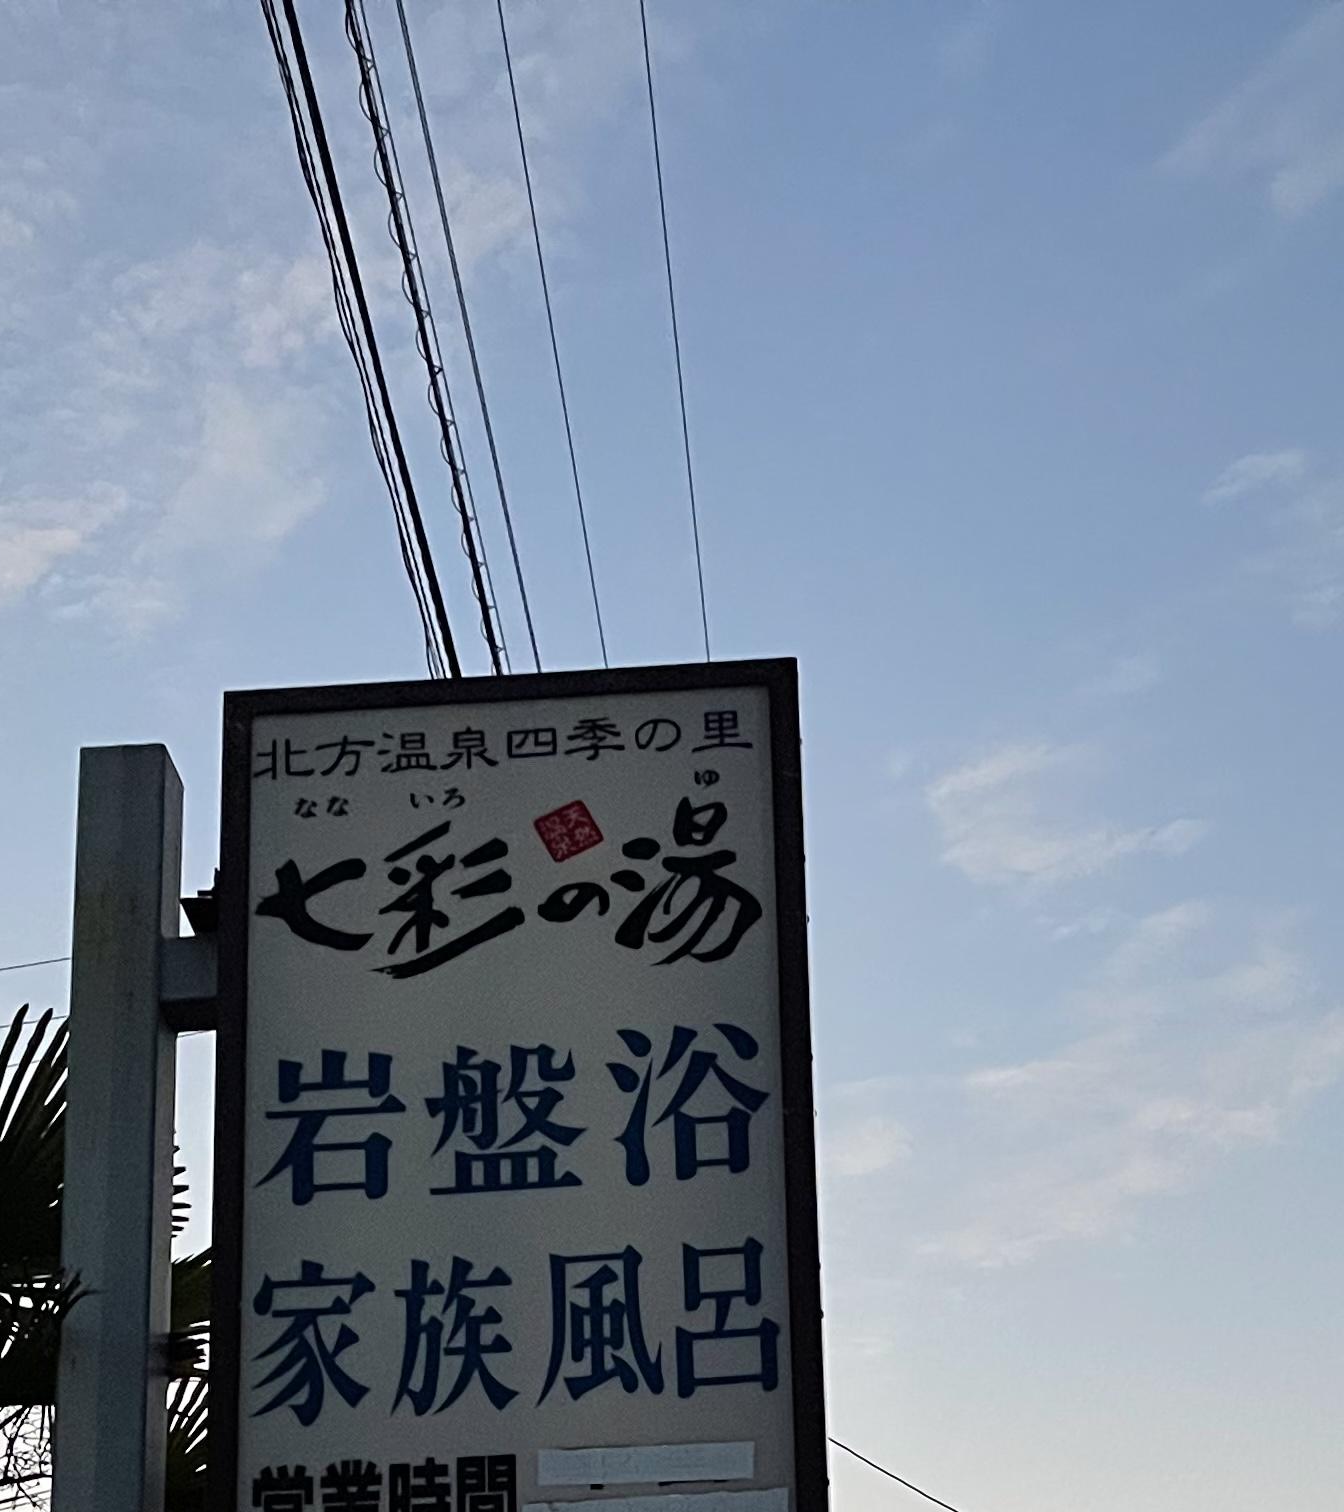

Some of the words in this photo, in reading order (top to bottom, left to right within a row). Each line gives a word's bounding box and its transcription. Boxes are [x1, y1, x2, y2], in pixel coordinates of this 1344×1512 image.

[252, 709, 754, 780] 北方温泉四季の里
[293, 796, 350, 819] なな
[409, 787, 467, 811] いろ
[693, 769, 720, 788] ゆ
[255, 797, 763, 980] 七彩の湯
[256, 1023, 770, 1206] 岩盤浴
[250, 1236, 780, 1427] 家族風呂
